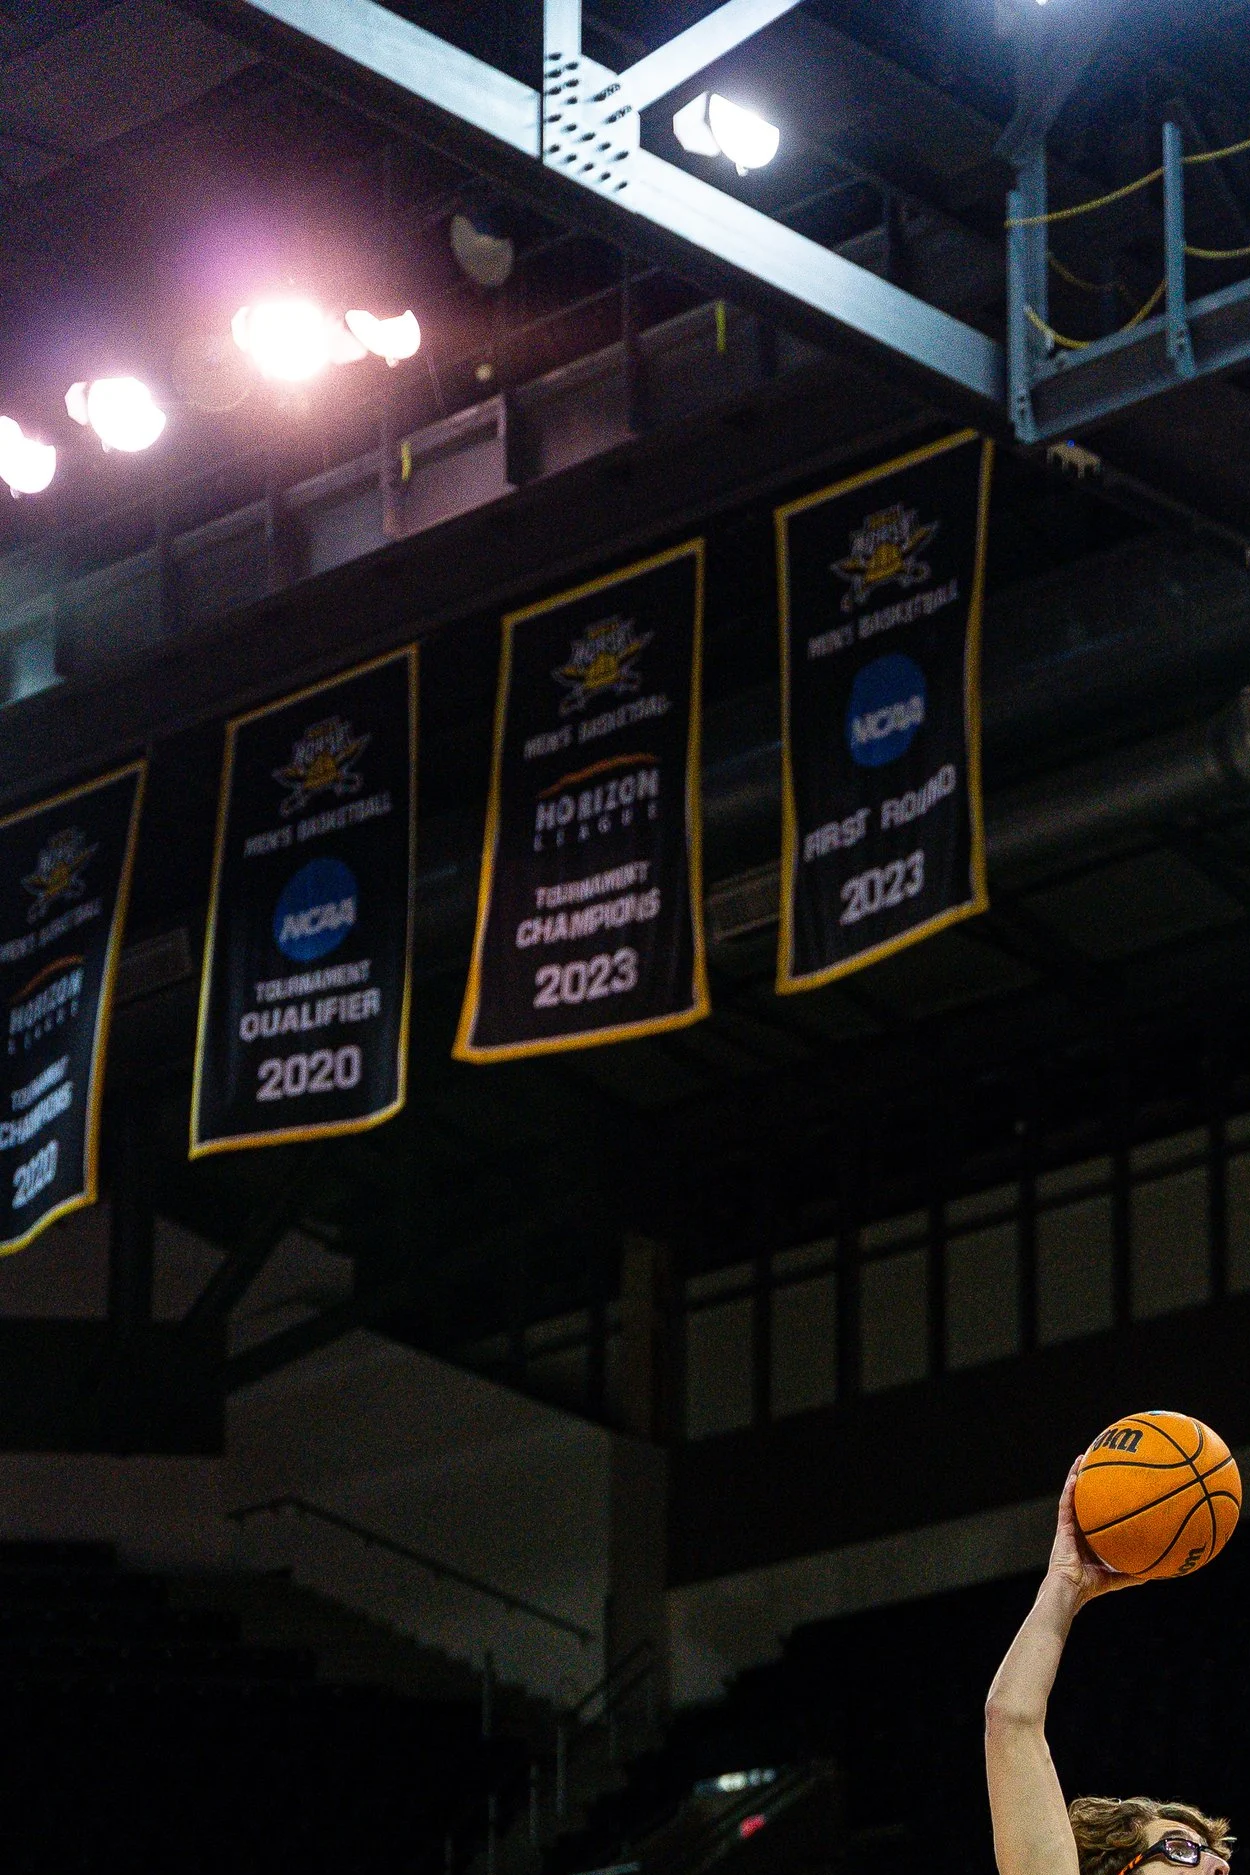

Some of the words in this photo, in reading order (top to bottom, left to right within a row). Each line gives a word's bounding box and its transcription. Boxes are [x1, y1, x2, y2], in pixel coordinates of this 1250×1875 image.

[851, 695, 927, 745] NCAA
[534, 768, 661, 833] HORIZON
[803, 807, 872, 863] FIRST
[880, 762, 957, 832] ROUND
[534, 859, 651, 911] TOURNAMENT
[838, 847, 925, 926] 2023
[279, 896, 357, 943] NCAA
[515, 886, 661, 950] CHAMPIONS
[255, 959, 372, 1004] TOURNAMENT
[532, 946, 639, 1010] 2023
[239, 987, 382, 1043] QUALIFIER
[255, 1044, 363, 1104] 2020
